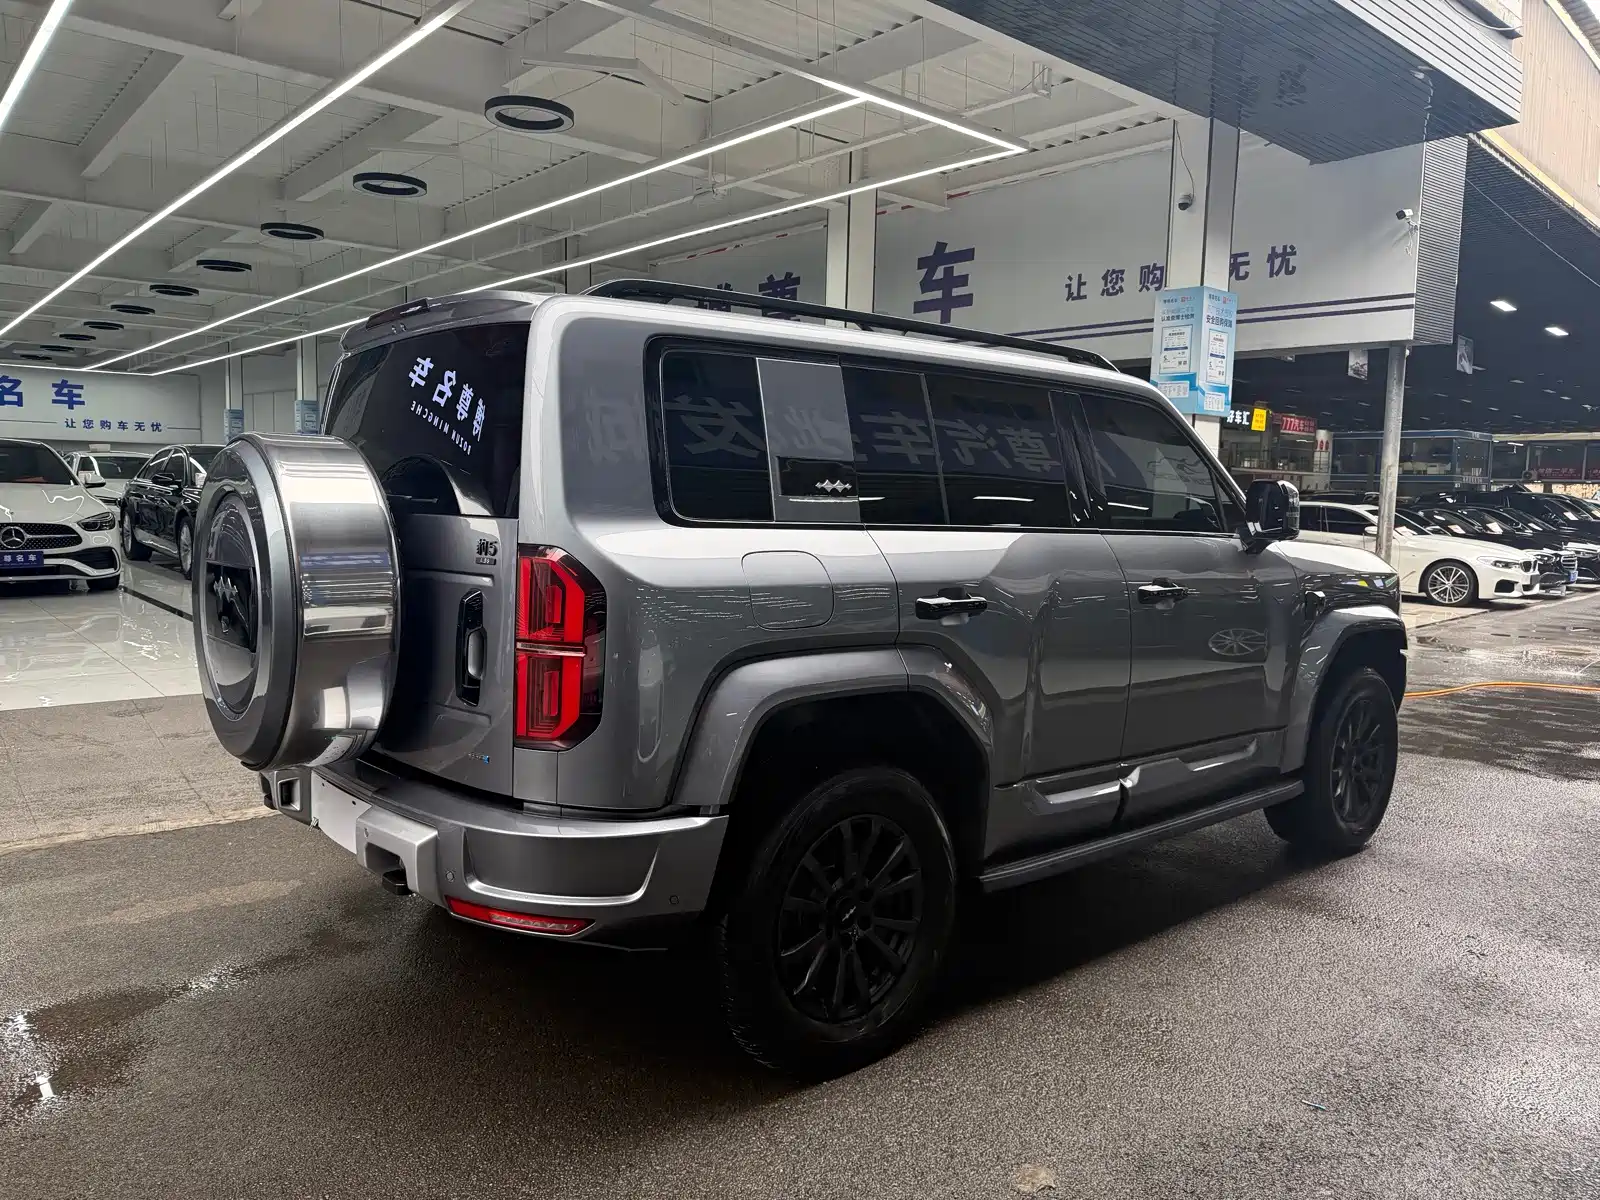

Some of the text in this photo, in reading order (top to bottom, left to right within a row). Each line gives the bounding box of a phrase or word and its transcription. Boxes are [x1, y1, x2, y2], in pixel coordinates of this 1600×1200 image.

[1065, 244, 1297, 303] 让您购无忧
[64, 417, 163, 432] 让您购车无忧
